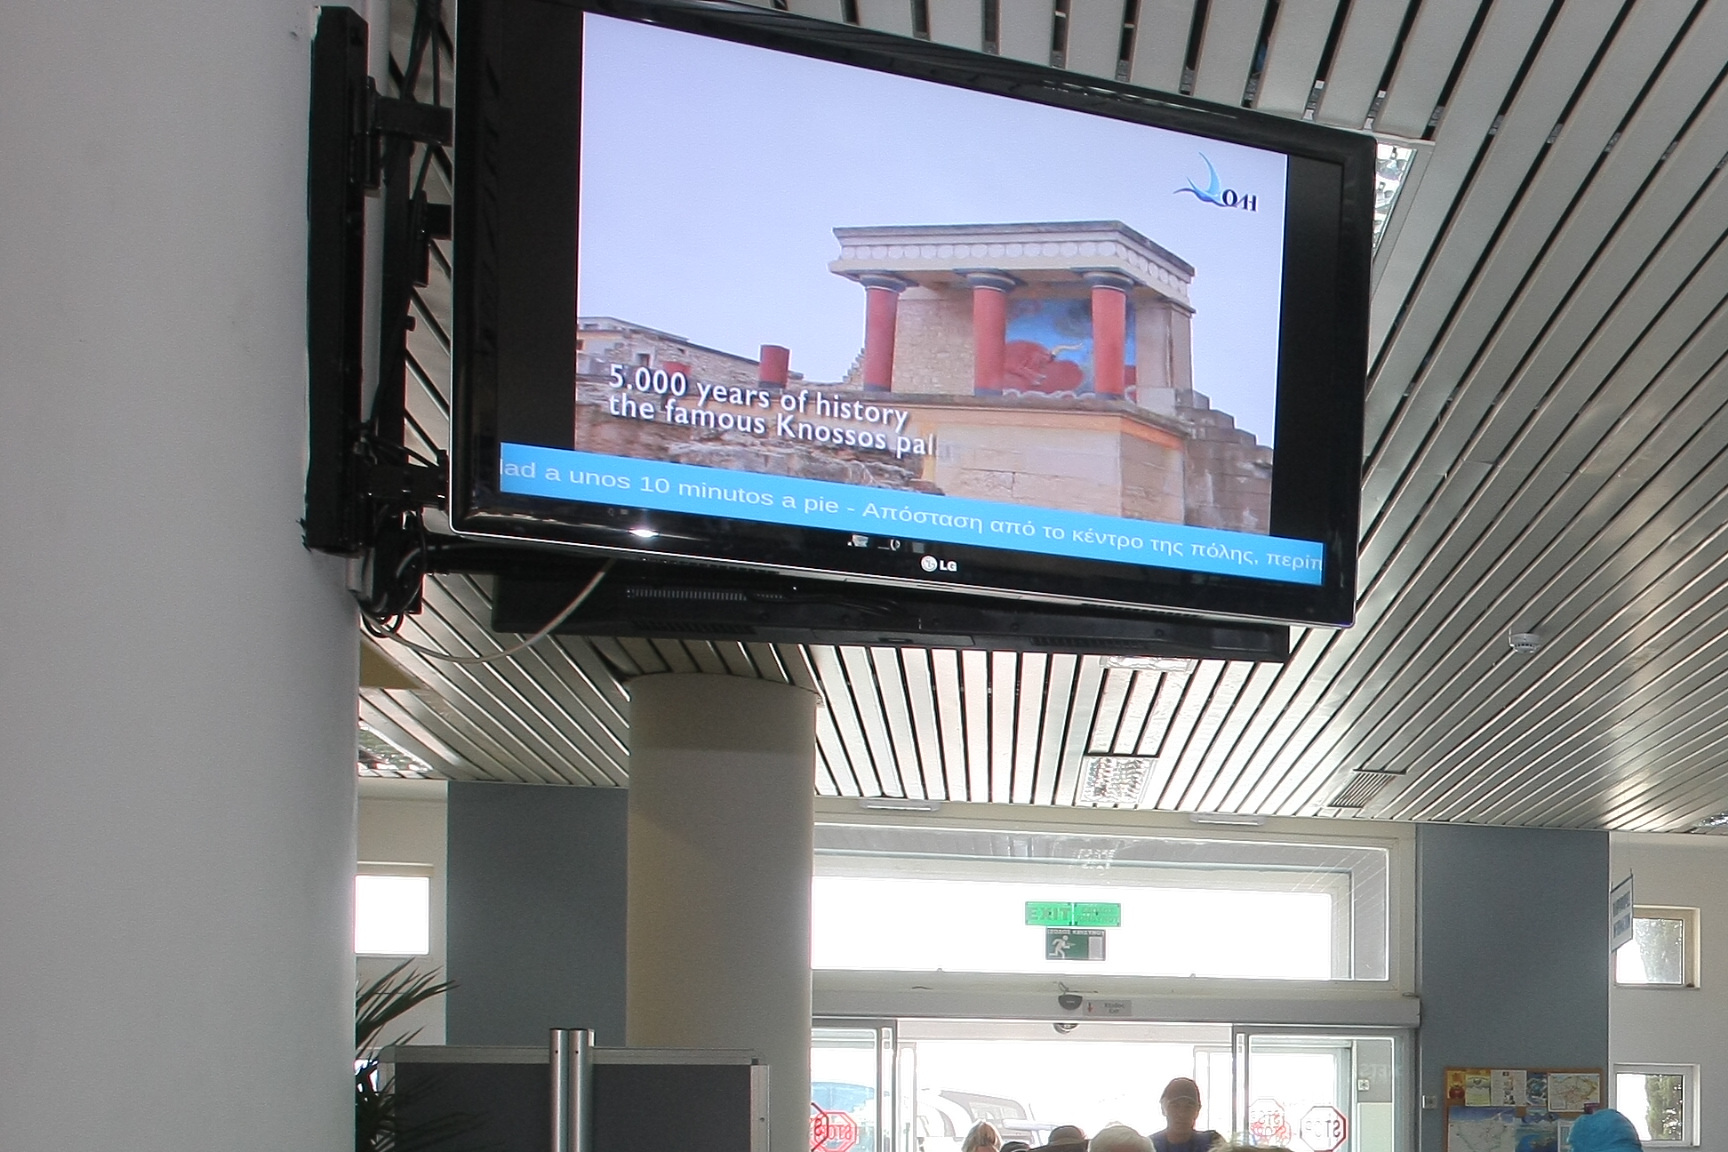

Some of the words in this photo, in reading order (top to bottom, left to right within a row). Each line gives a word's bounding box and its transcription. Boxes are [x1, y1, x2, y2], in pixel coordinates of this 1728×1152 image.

[608, 392, 655, 419] the
[665, 398, 766, 434] famous
[776, 413, 886, 450] Knossos
[609, 363, 688, 397] 5.000
[696, 379, 770, 408] years
[780, 388, 809, 412] of
[816, 391, 909, 433] history
[545, 468, 561, 482] a
[569, 469, 631, 490] unos
[640, 475, 670, 495] 10
[679, 482, 774, 507] minutos
[782, 494, 796, 509] a
[804, 494, 839, 520] pie
[862, 501, 983, 534] Απόσταση
[990, 517, 1036, 539] από
[1042, 524, 1066, 541] το
[1072, 527, 1144, 556] κέντρο
[1150, 538, 1184, 558] της
[1191, 537, 1259, 566] πόλης,
[939, 559, 957, 572] LG
[1029, 907, 1071, 921] EXIT
